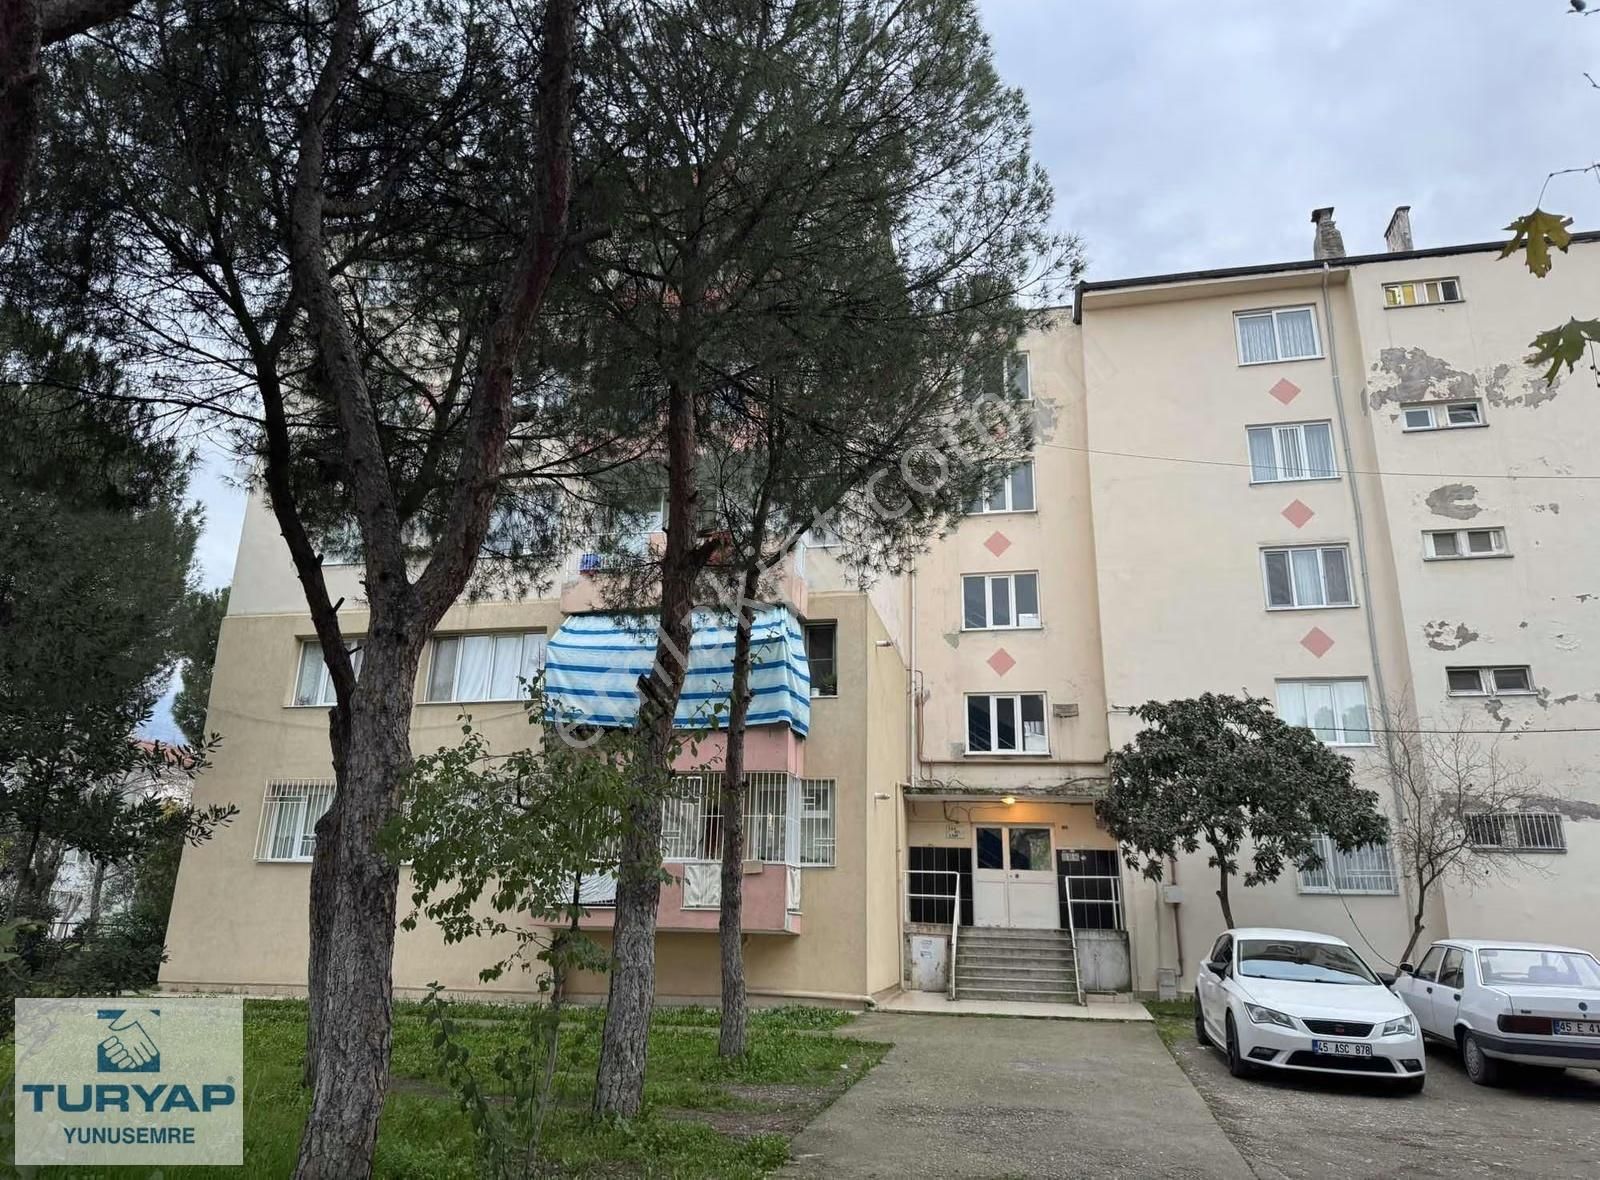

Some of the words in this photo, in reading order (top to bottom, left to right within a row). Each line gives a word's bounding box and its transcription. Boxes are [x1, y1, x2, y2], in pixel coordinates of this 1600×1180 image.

[1318, 1042, 1329, 1052] 45
[1335, 1043, 1350, 1054] ASC
[1355, 1044, 1371, 1056] 878
